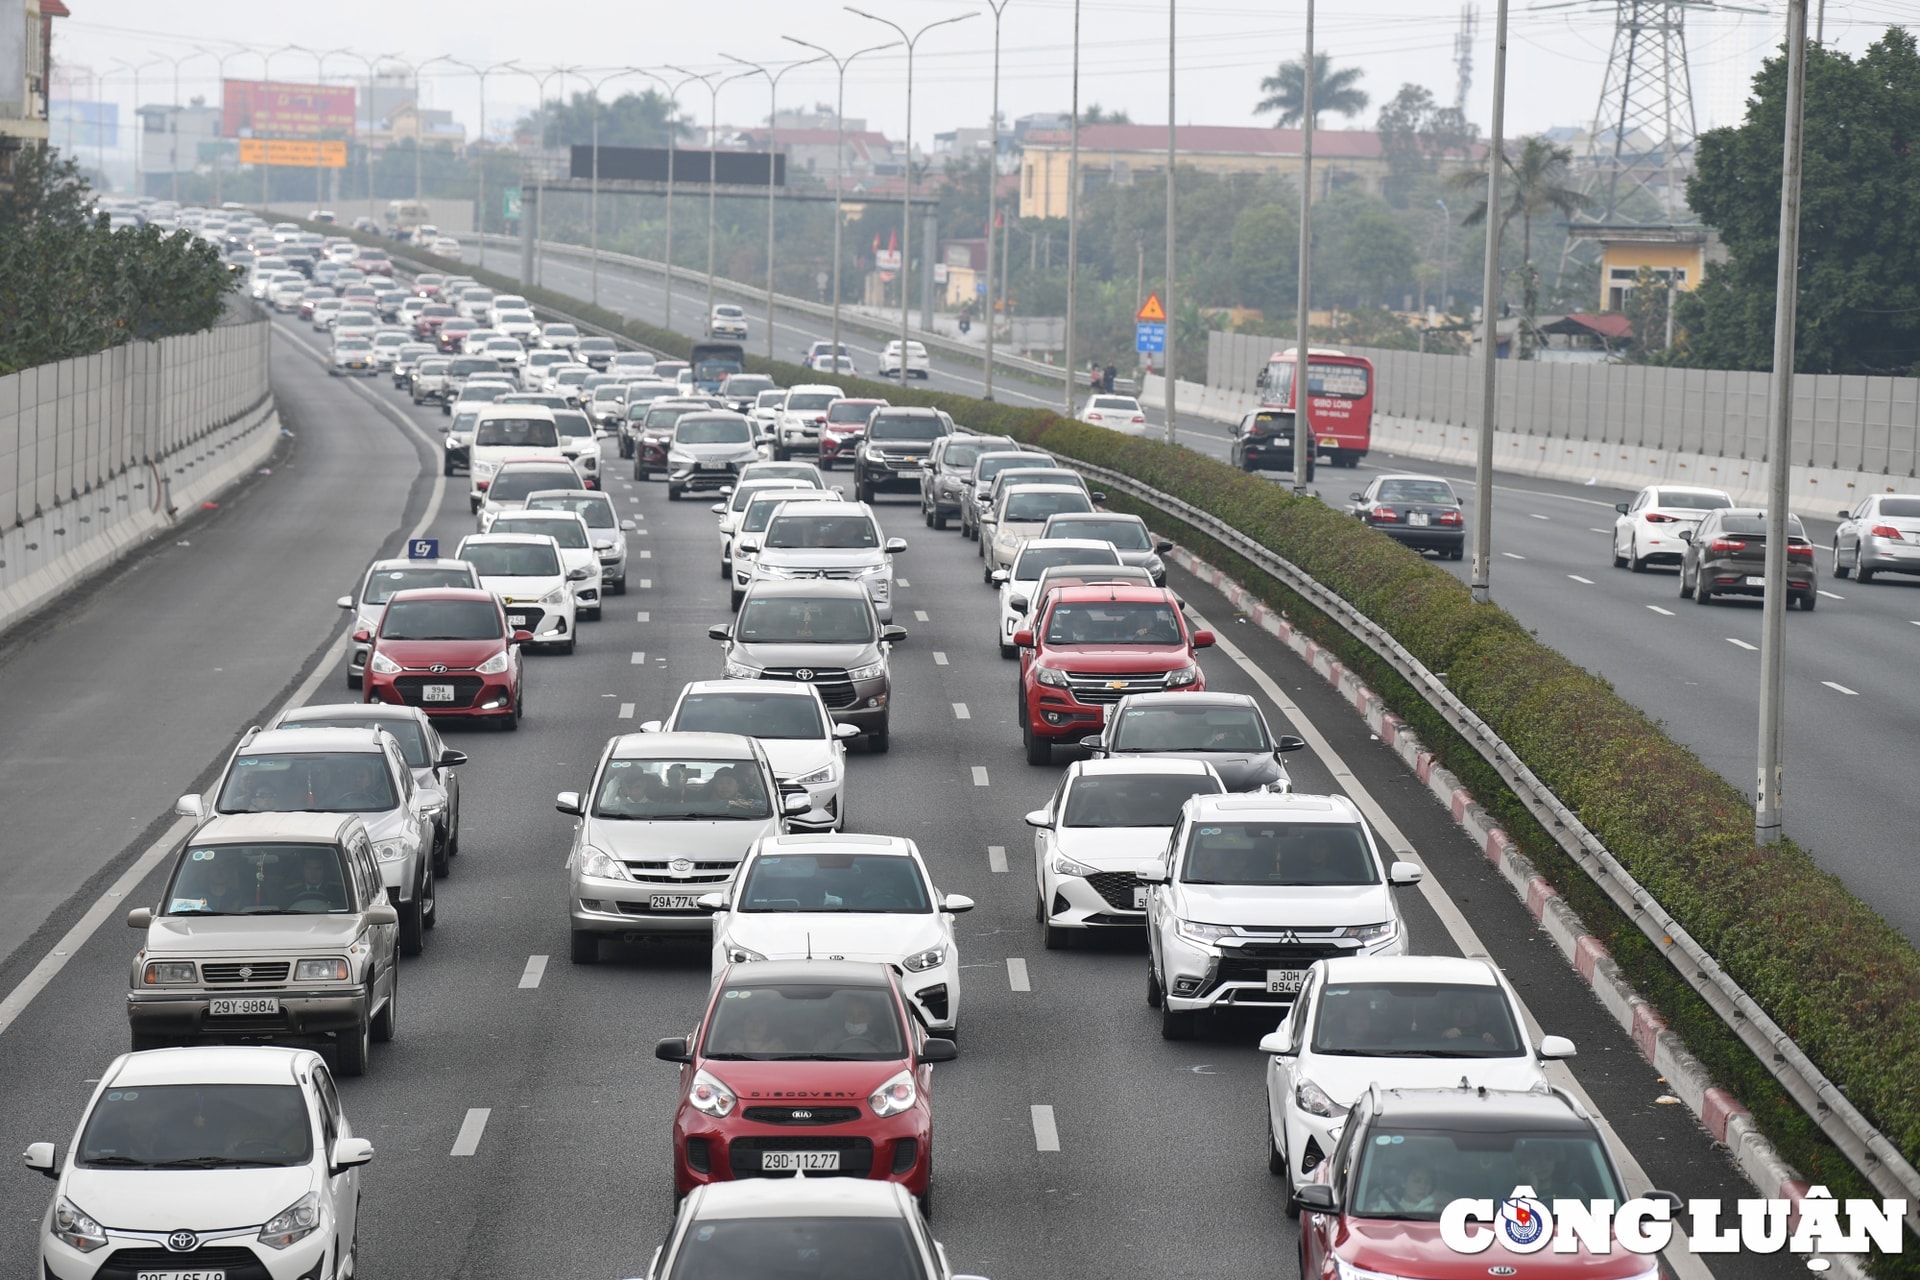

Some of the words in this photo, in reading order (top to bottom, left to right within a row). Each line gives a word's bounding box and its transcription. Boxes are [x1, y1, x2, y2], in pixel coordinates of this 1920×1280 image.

[652, 896, 701, 908] 29A-774.
[1280, 971, 1300, 981] 30H
[1271, 981, 1301, 992] 894.6
[213, 1000, 275, 1014] 29Y-9884
[793, 1110, 811, 1119] KIA
[764, 1154, 837, 1169] 29D-112.77
[1491, 1266, 1513, 1275] KIA
